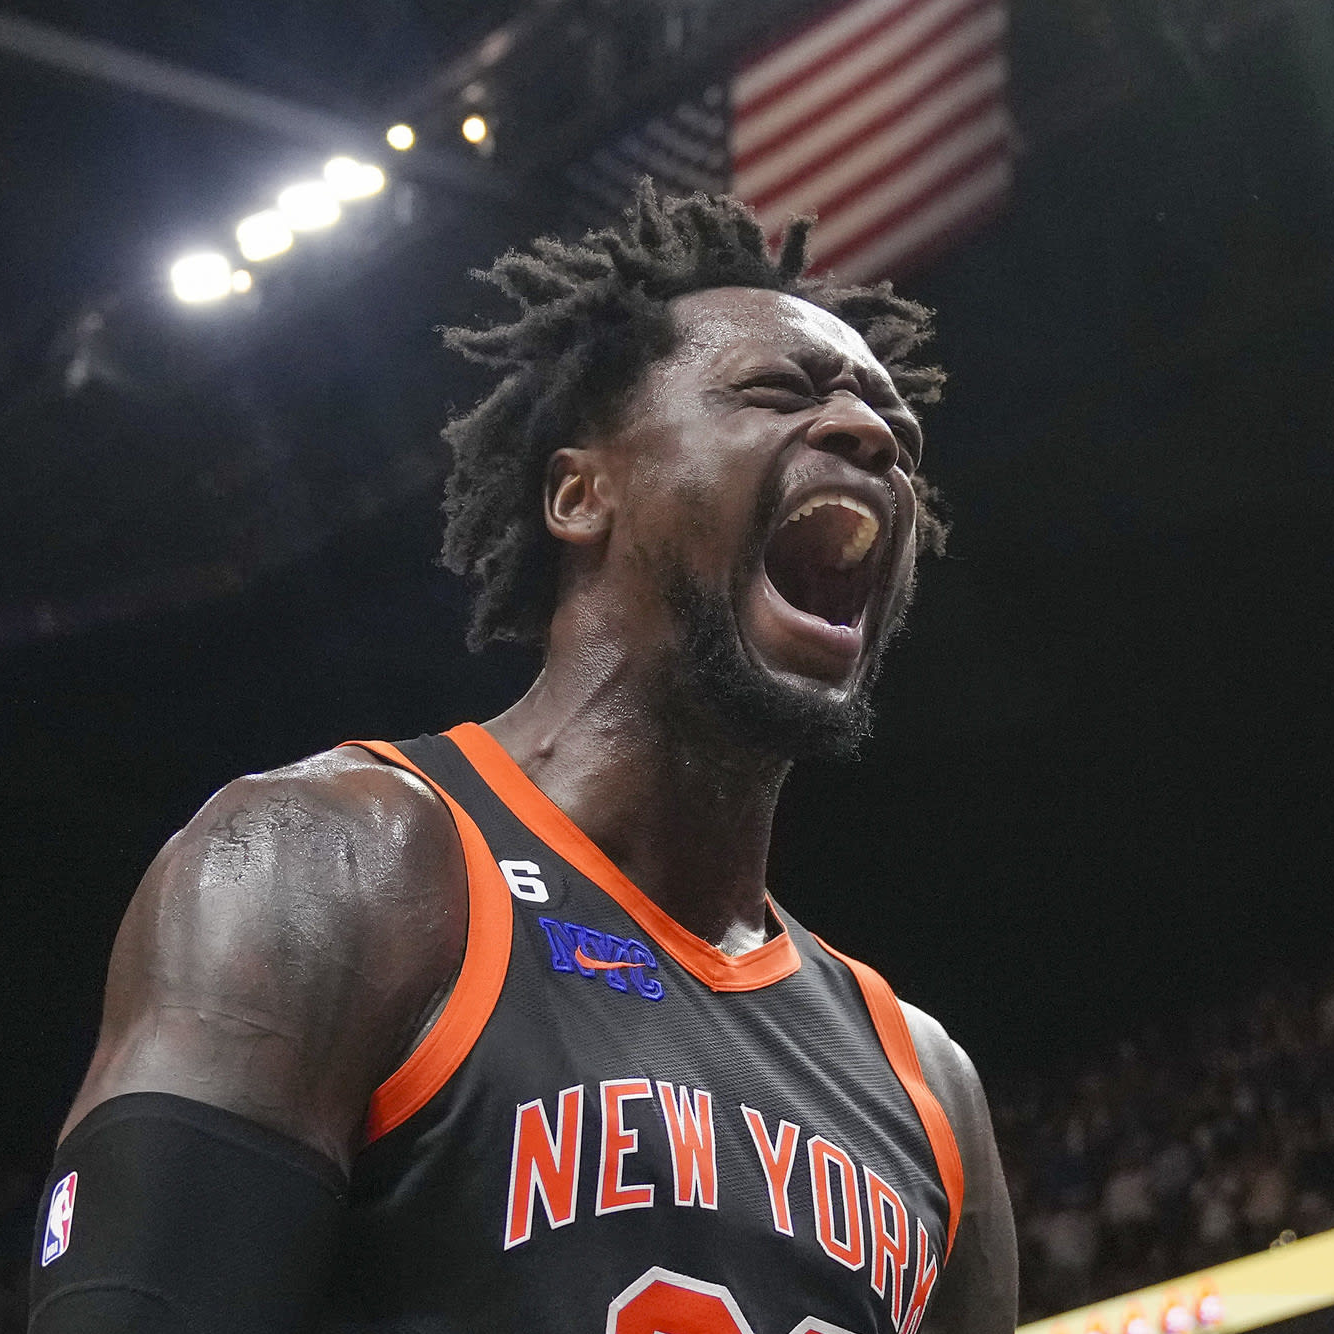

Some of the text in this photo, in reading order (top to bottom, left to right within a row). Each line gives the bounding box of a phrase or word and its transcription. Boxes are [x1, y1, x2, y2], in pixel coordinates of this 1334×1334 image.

[499, 860, 549, 903] 6
[539, 917, 665, 1001] NYC
[503, 1078, 718, 1251] NEW
